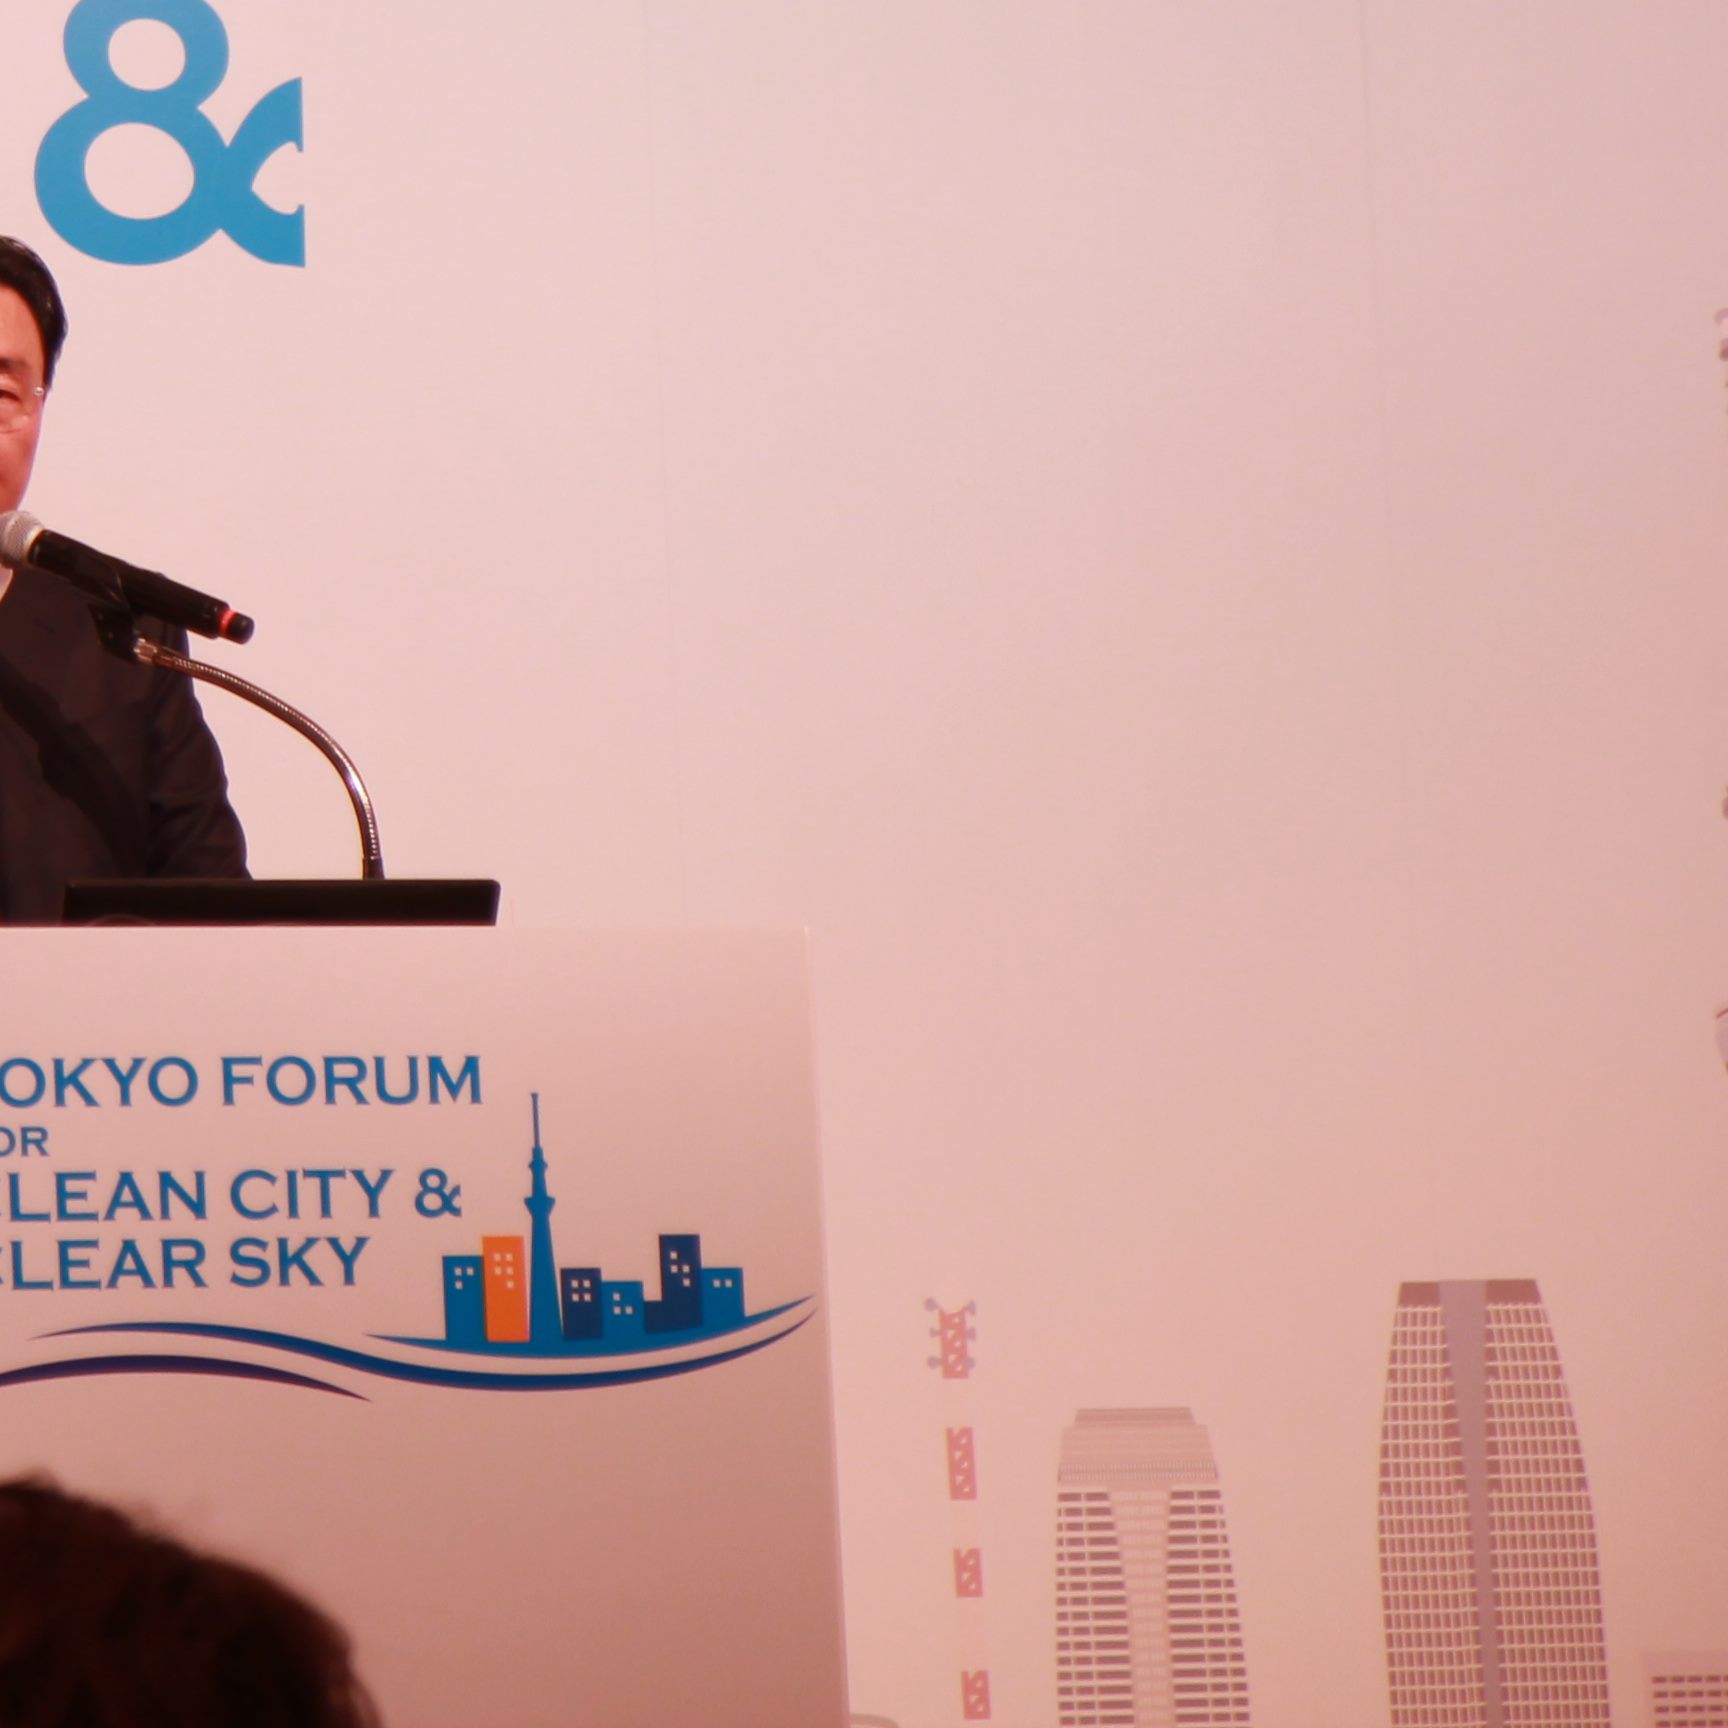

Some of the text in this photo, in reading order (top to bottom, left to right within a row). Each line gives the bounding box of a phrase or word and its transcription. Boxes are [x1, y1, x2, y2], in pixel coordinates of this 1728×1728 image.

[220, 1055, 482, 1106] FORUM
[229, 1167, 394, 1220] CITY
[415, 1167, 463, 1218] &
[229, 1235, 370, 1288] SKY
